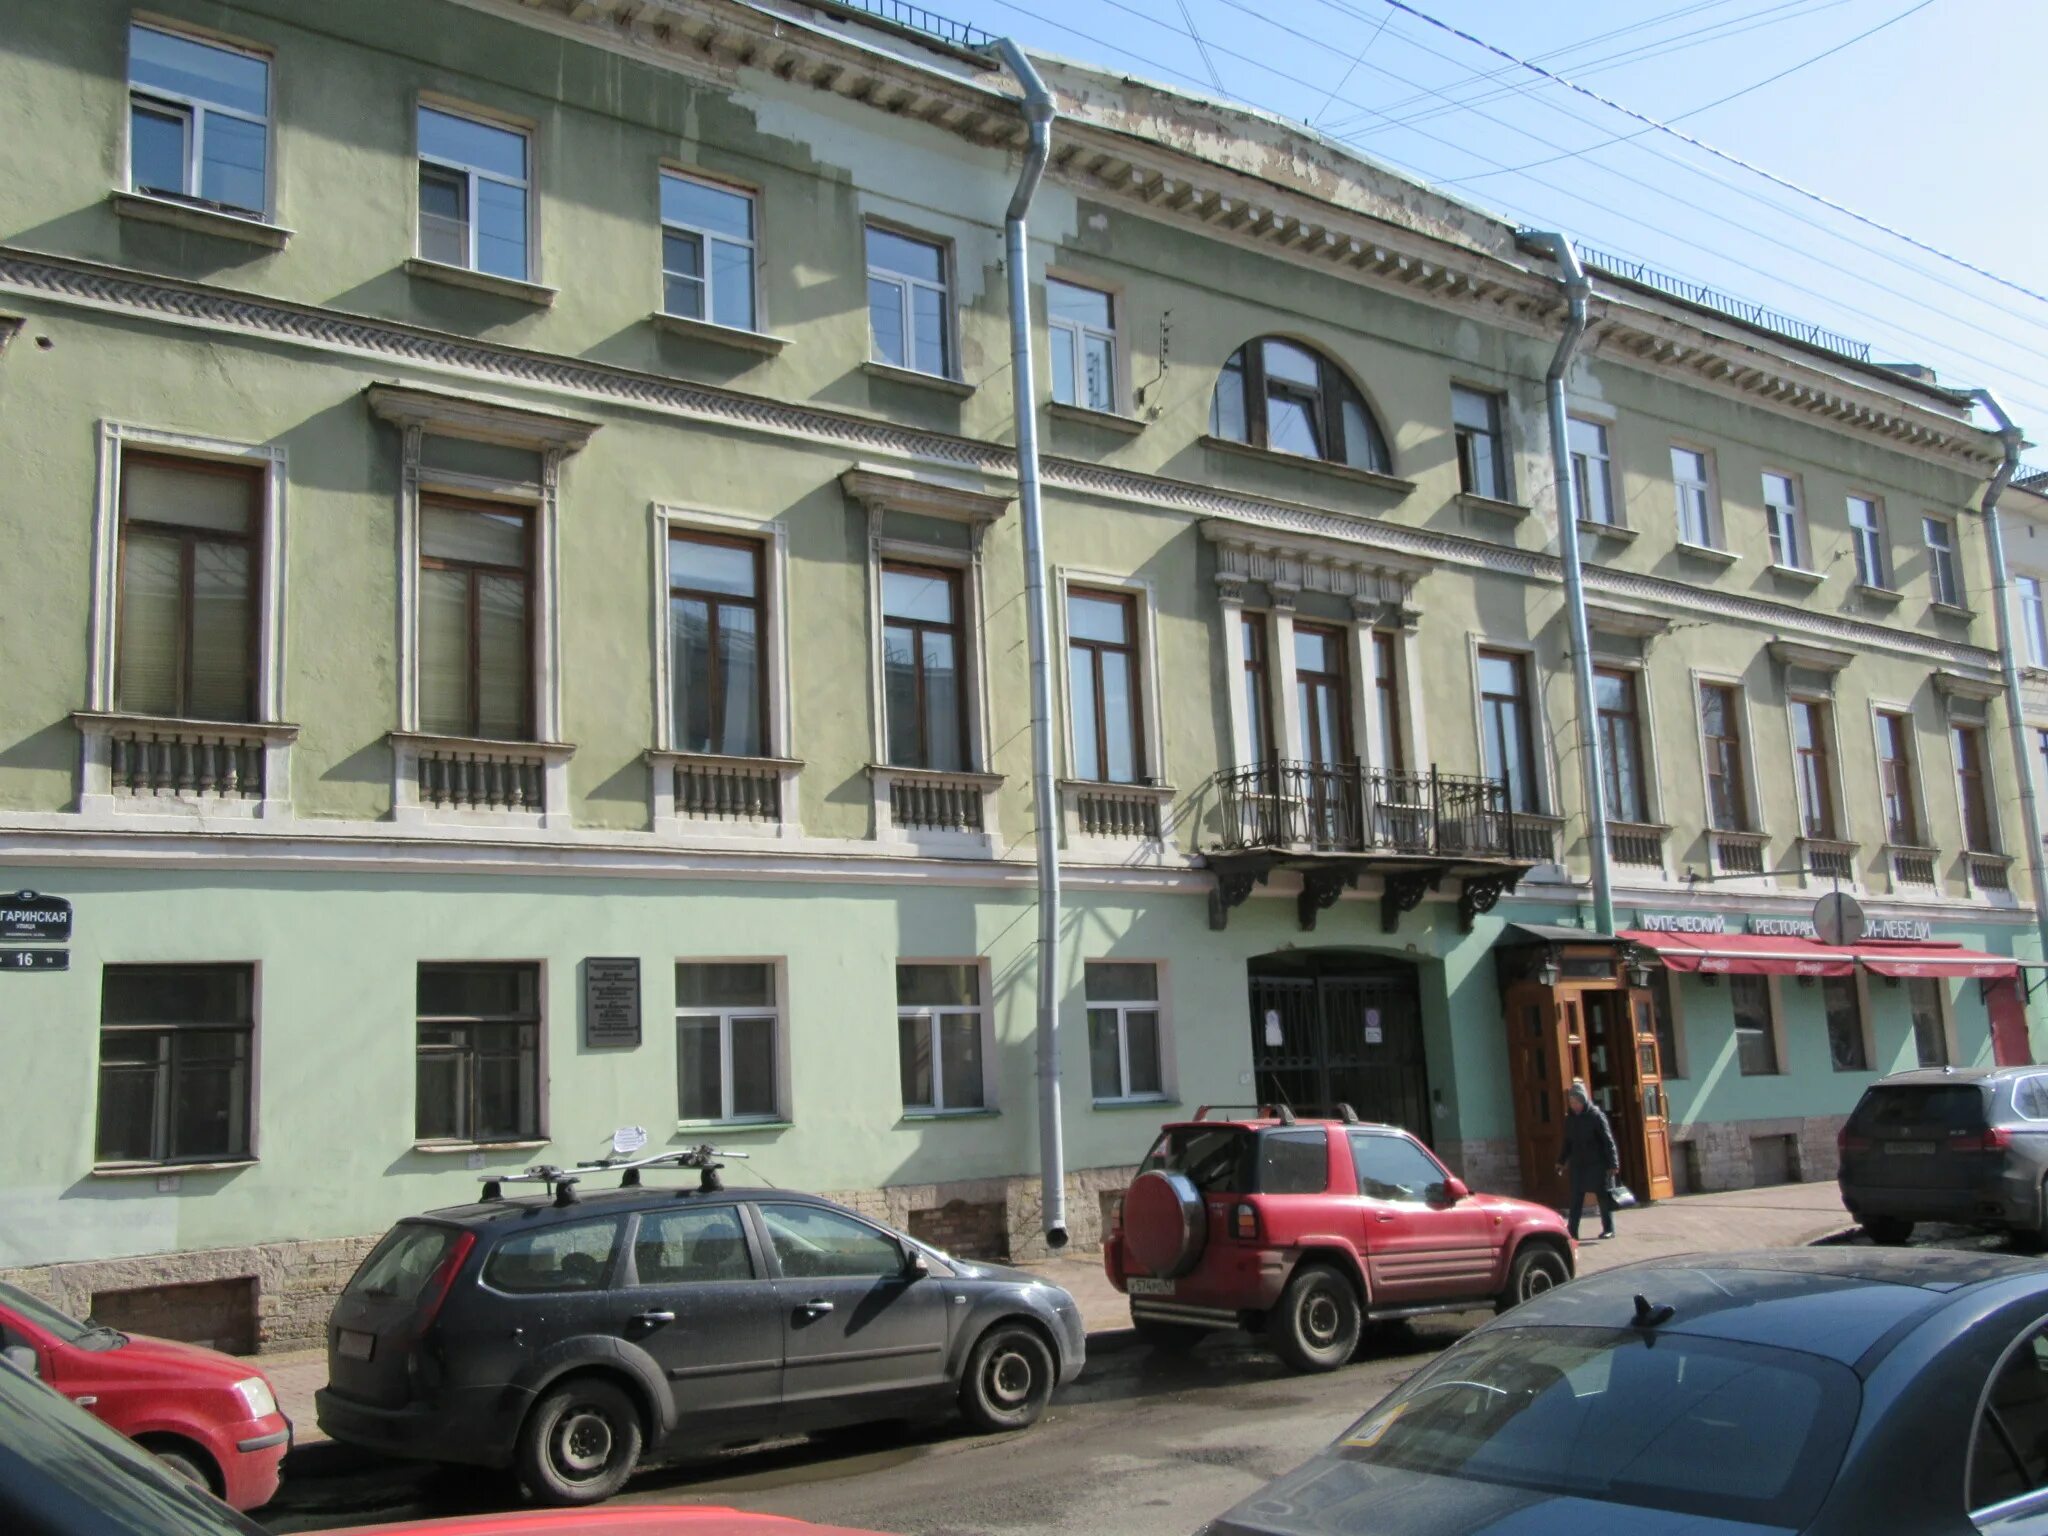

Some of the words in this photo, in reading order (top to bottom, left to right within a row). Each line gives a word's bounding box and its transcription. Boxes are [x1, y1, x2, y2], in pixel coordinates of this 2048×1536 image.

[1643, 914, 1726, 933] КУПЕЧЕСКИЙ
[1755, 919, 1814, 936] РЕСТОРАН
[17, 952, 33, 966] 16
